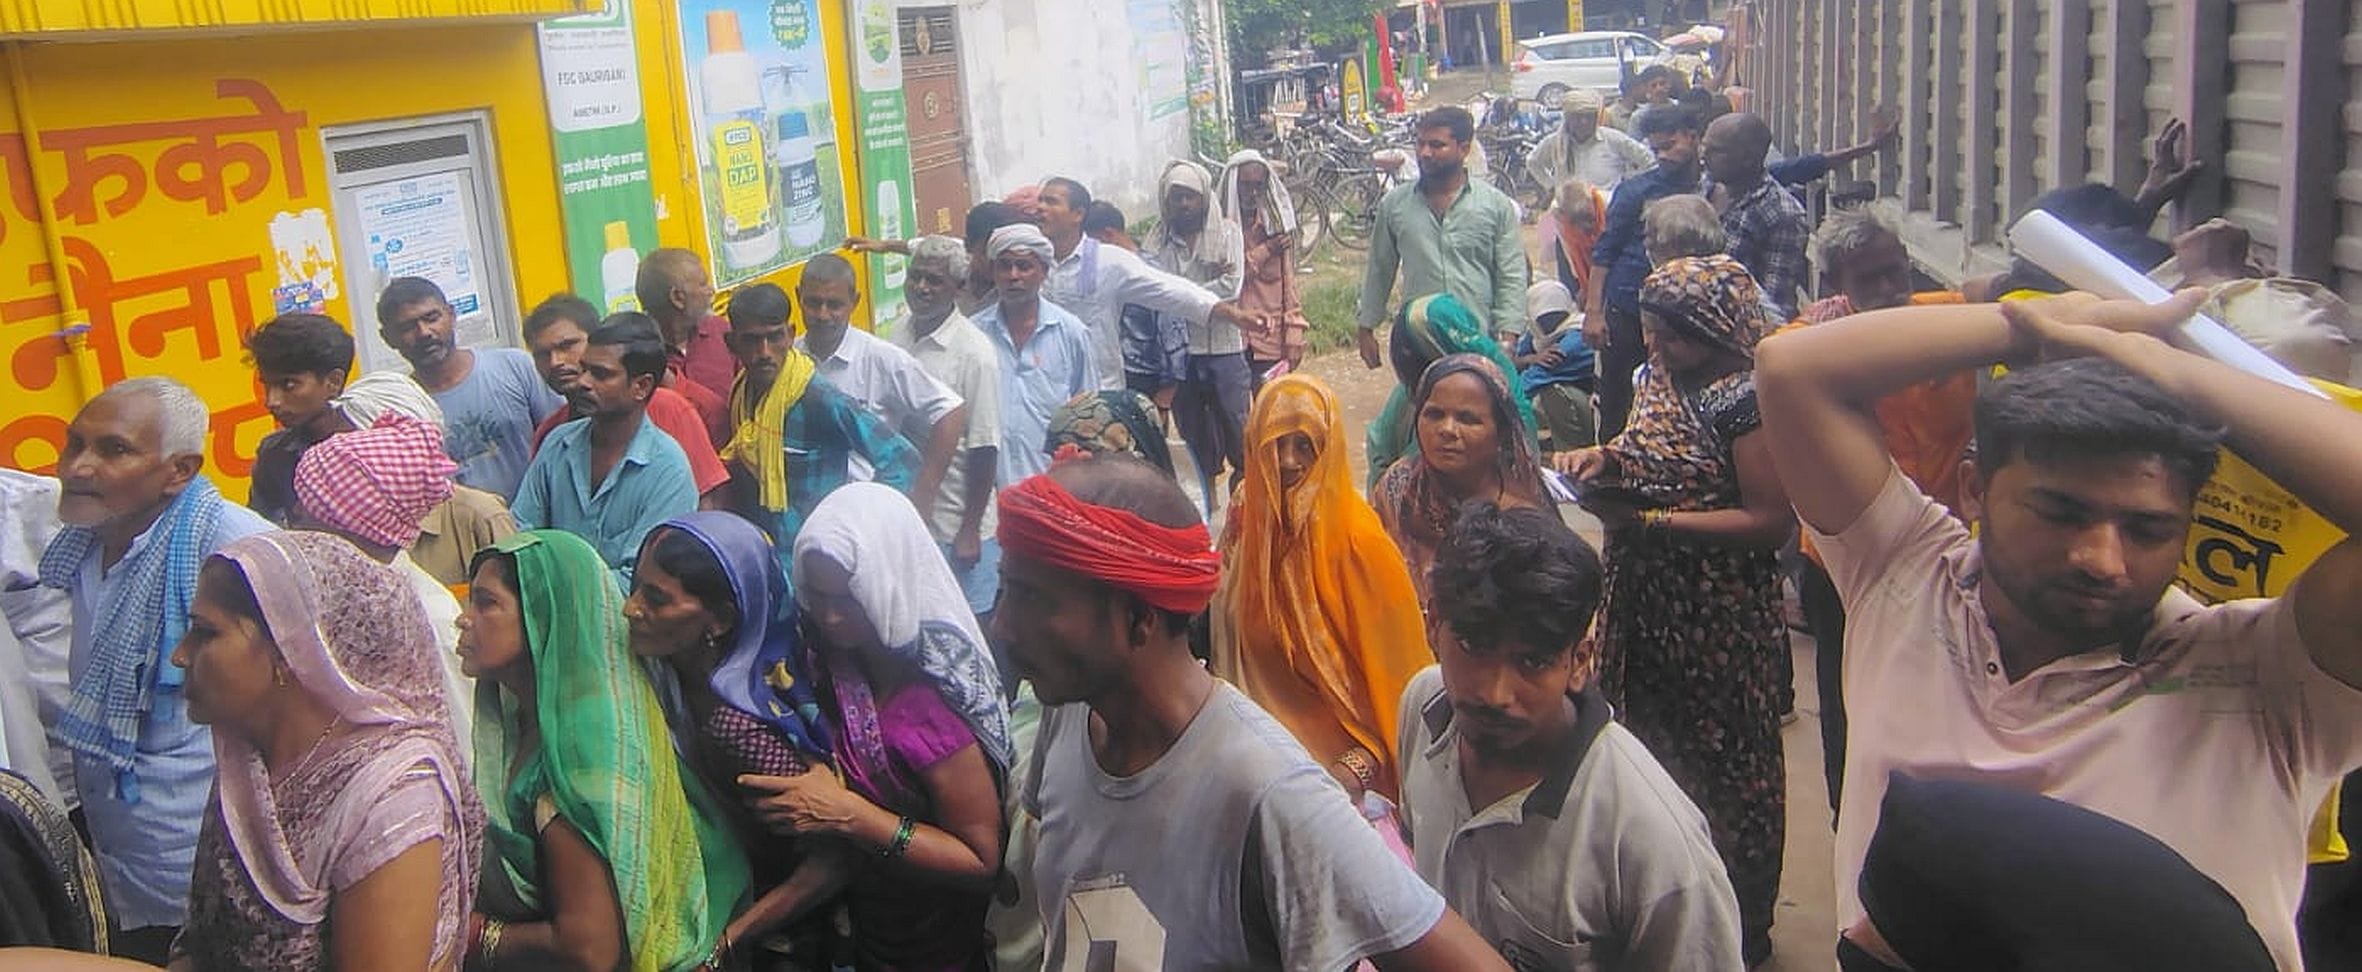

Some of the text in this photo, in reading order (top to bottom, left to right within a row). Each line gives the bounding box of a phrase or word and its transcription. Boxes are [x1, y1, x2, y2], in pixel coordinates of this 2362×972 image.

[0, 79, 308, 236] फको
[728, 166, 758, 187] DAP
[791, 174, 817, 188] NANO
[792, 187, 815, 200] ZINC
